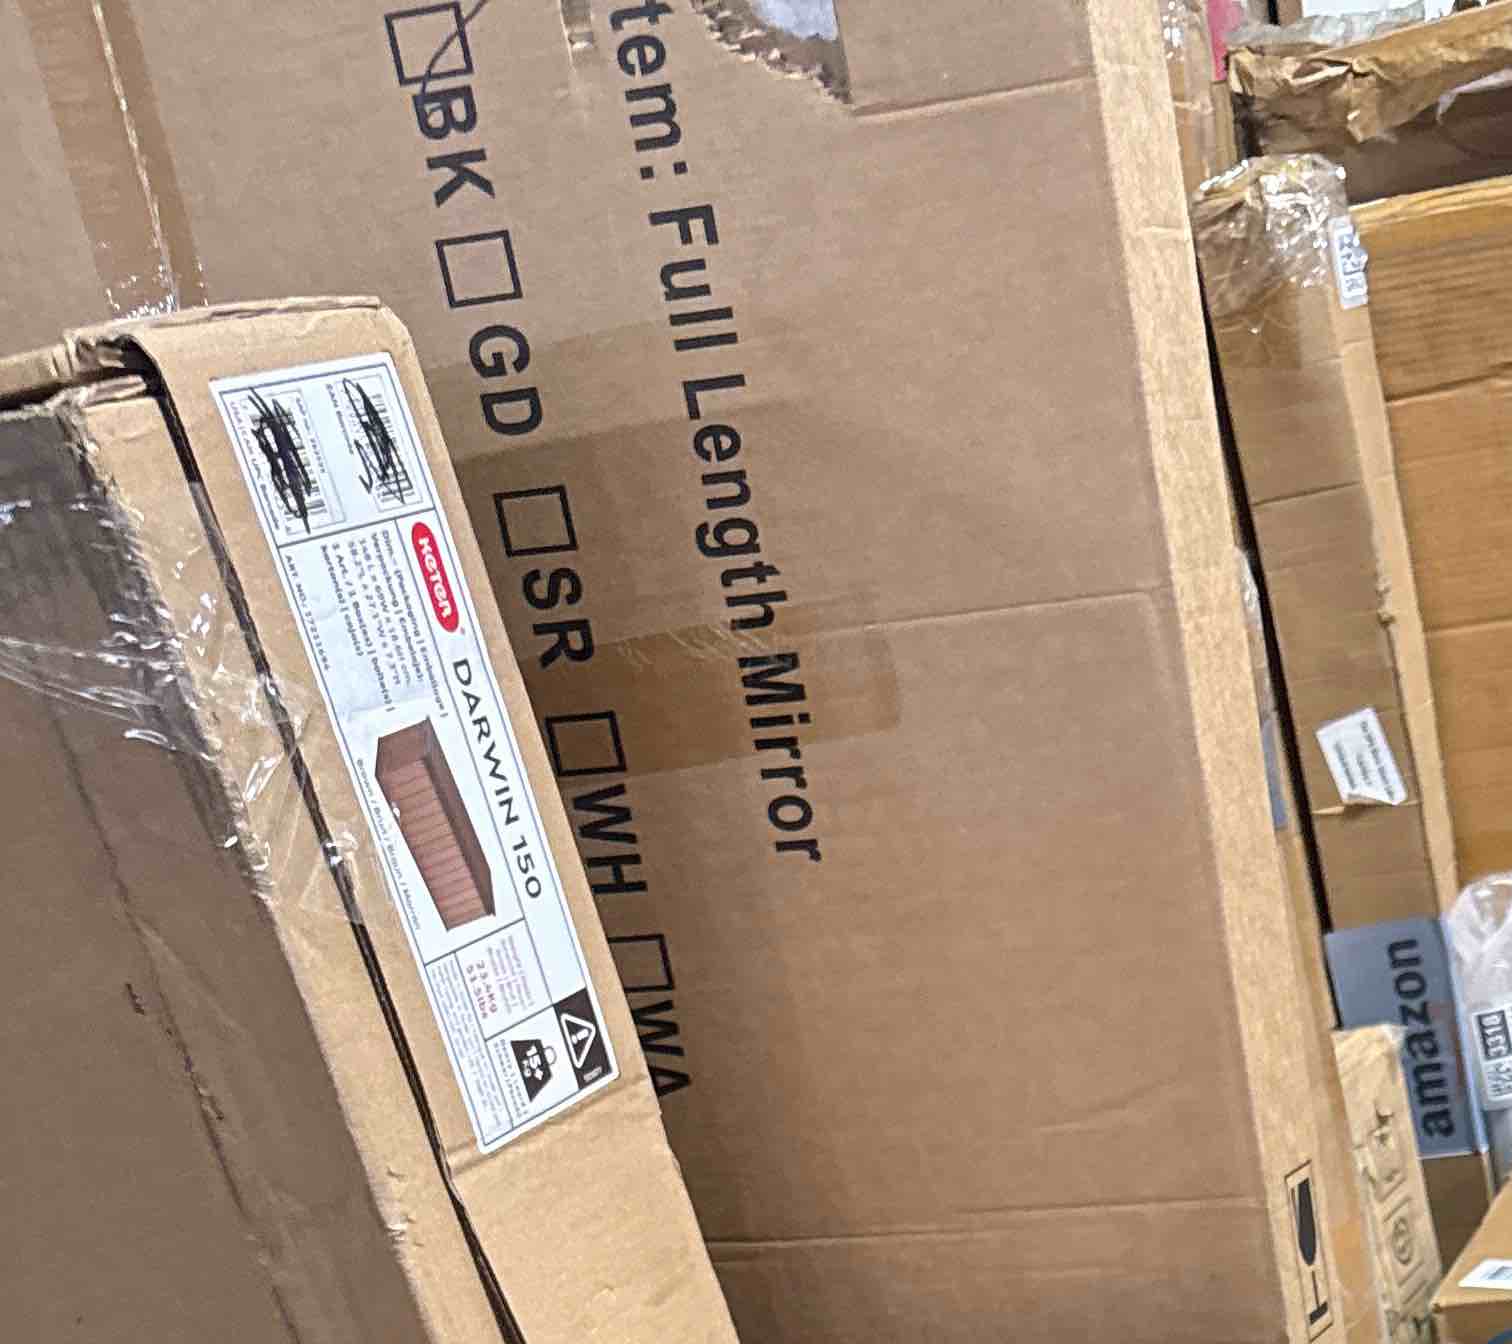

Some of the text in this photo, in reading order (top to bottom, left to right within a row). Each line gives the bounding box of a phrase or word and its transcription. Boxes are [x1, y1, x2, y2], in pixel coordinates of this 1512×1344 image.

[648, 204, 738, 352] Full
[412, 85, 496, 208] BK
[468, 324, 543, 437] GD
[521, 567, 595, 669] SR
[571, 783, 648, 898] WH
[683, 374, 788, 633] Length
[452, 659, 520, 827] DARWIN
[511, 829, 544, 900] 150
[737, 652, 821, 863] Mirror
[1387, 938, 1455, 1138] amazon
